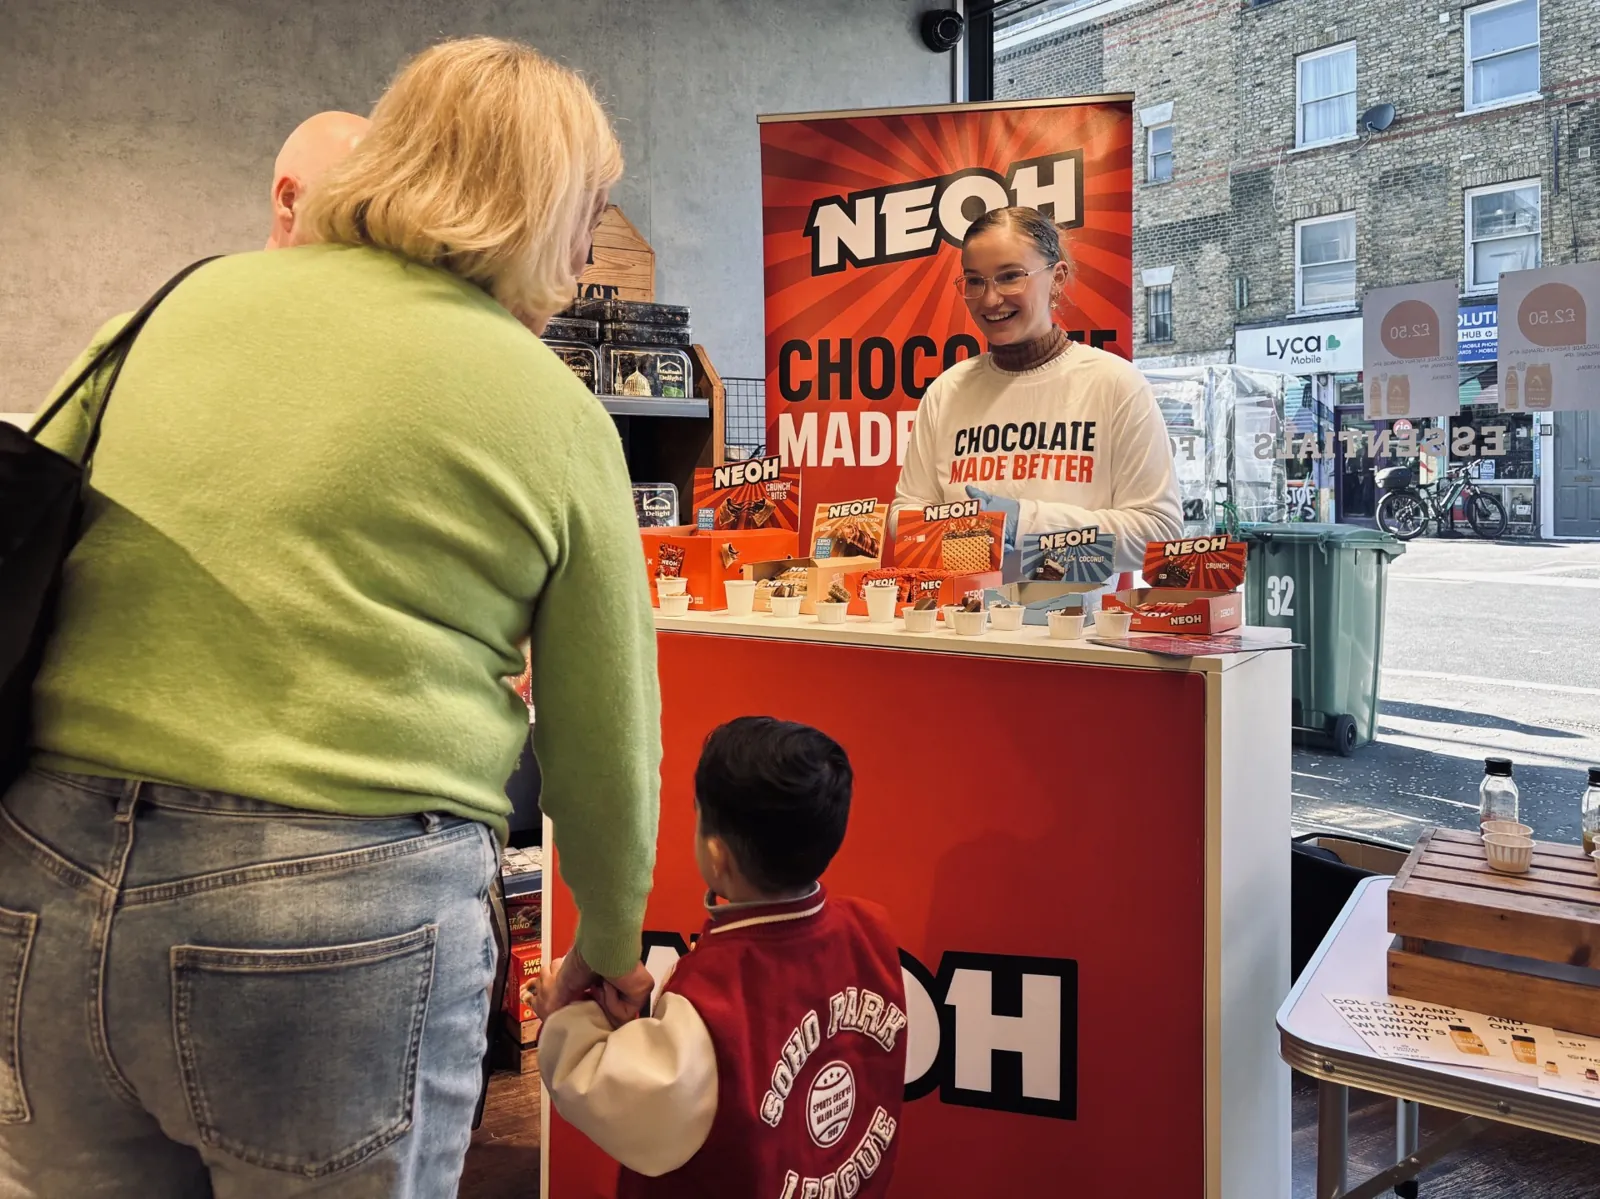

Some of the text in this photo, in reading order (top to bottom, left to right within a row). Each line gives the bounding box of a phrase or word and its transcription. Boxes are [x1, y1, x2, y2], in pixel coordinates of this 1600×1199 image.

[812, 157, 1076, 269] NEOH
[1462, 331, 1481, 340] HUB
[1267, 335, 1322, 360] Lyca
[1290, 354, 1322, 365] Mobile
[954, 421, 1096, 457] CHOCOLATE
[714, 457, 779, 489] NEOH
[949, 453, 1094, 484] MADE BETTER
[766, 482, 790, 491] CRUNCH
[771, 491, 786, 500] BITES
[829, 500, 874, 519] NEOH
[925, 501, 978, 521] NEOH
[1040, 528, 1096, 549] NEOH
[1164, 536, 1228, 556] NEOH
[1079, 555, 1105, 563] COCONUT
[867, 578, 896, 588] NEOH
[1267, 575, 1295, 616] 32
[1170, 614, 1202, 626] NEOH
[1370, 1001, 1457, 1016] COLD AND
[1374, 1008, 1465, 1024] FLU WON'T
[1376, 1015, 1429, 1026] KNOW
[1487, 1016, 1524, 1026] AND
[1489, 1023, 1531, 1034] ON'T
[1380, 1023, 1447, 1036] WHAT'S
[1384, 1031, 1411, 1039] HIT
[760, 986, 908, 1128] SOHO PARK
[812, 1097, 833, 1114] SPORTS
[816, 1098, 850, 1125] MAJOR LEAGUE
